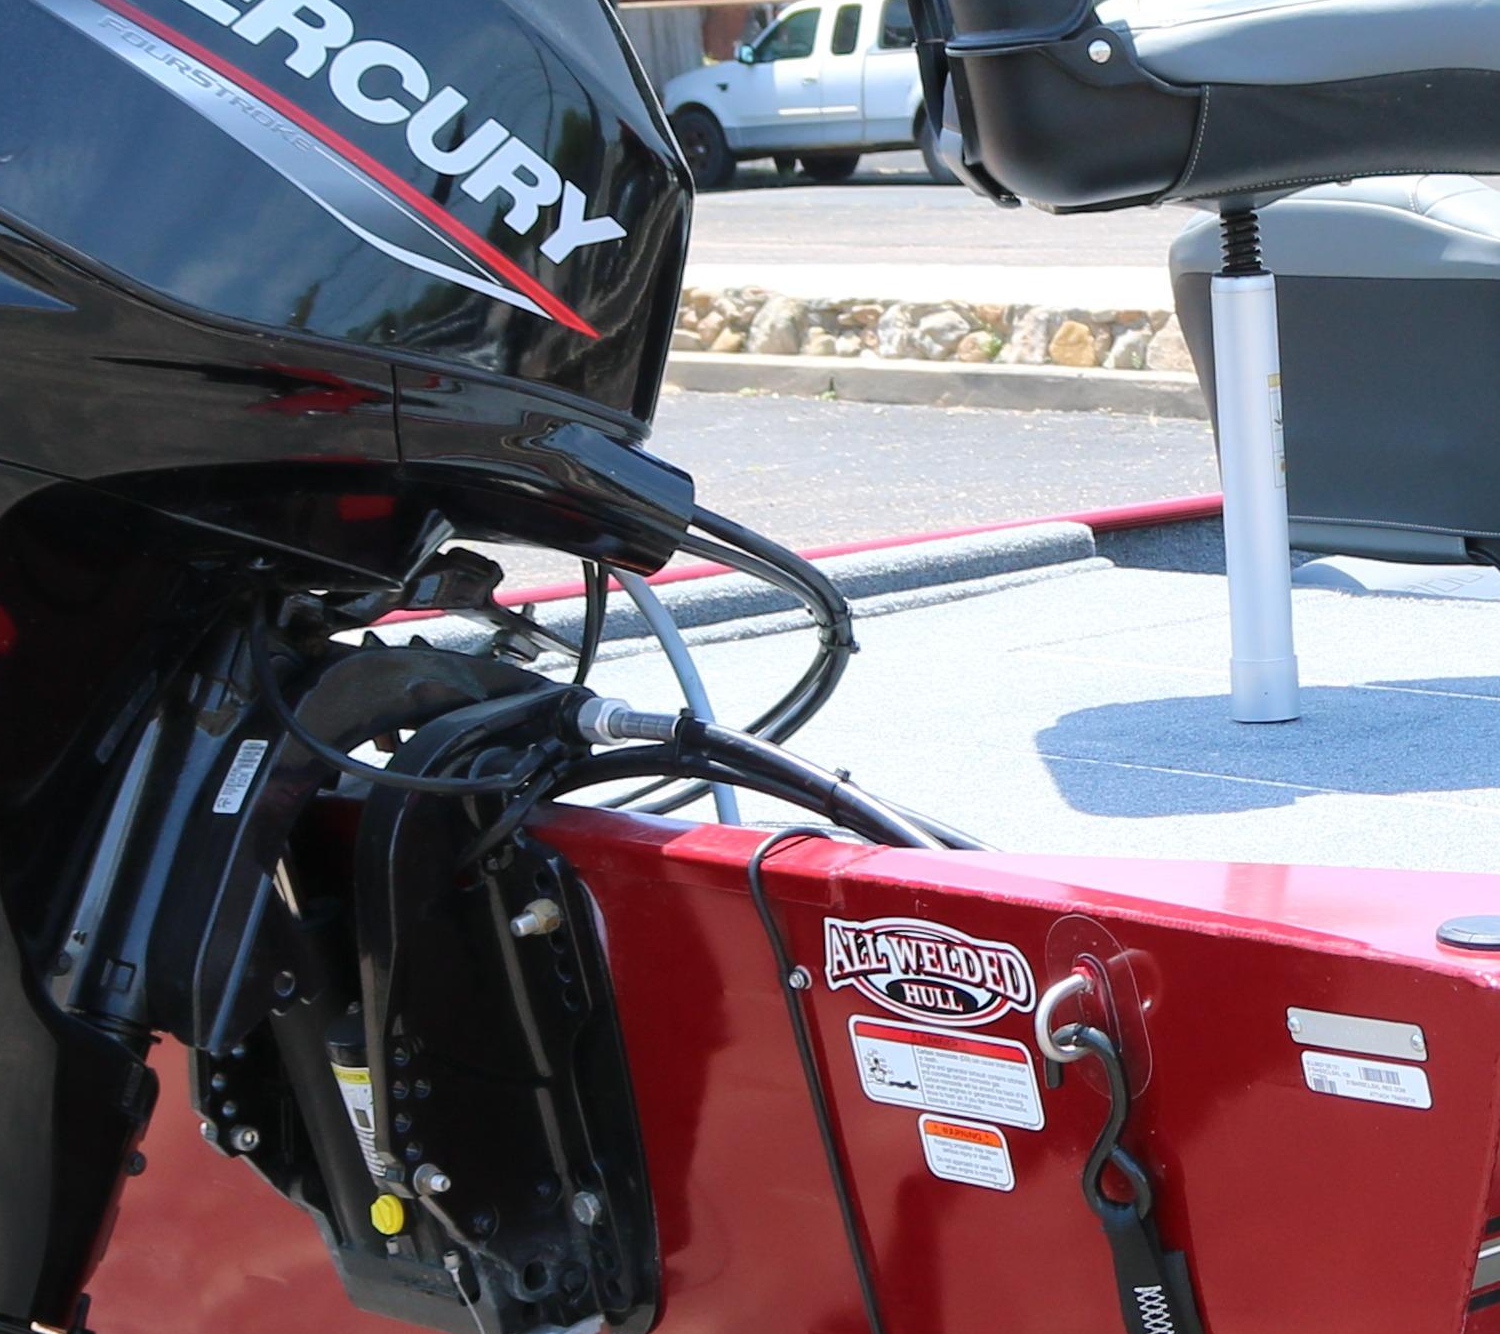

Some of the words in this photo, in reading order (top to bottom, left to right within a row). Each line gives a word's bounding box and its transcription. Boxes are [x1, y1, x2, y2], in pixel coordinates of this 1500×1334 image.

[97, 13, 314, 153] FOURSTROKE
[831, 924, 888, 977] ALL
[887, 934, 1029, 1003] WELDED
[900, 982, 964, 1012] HULL
